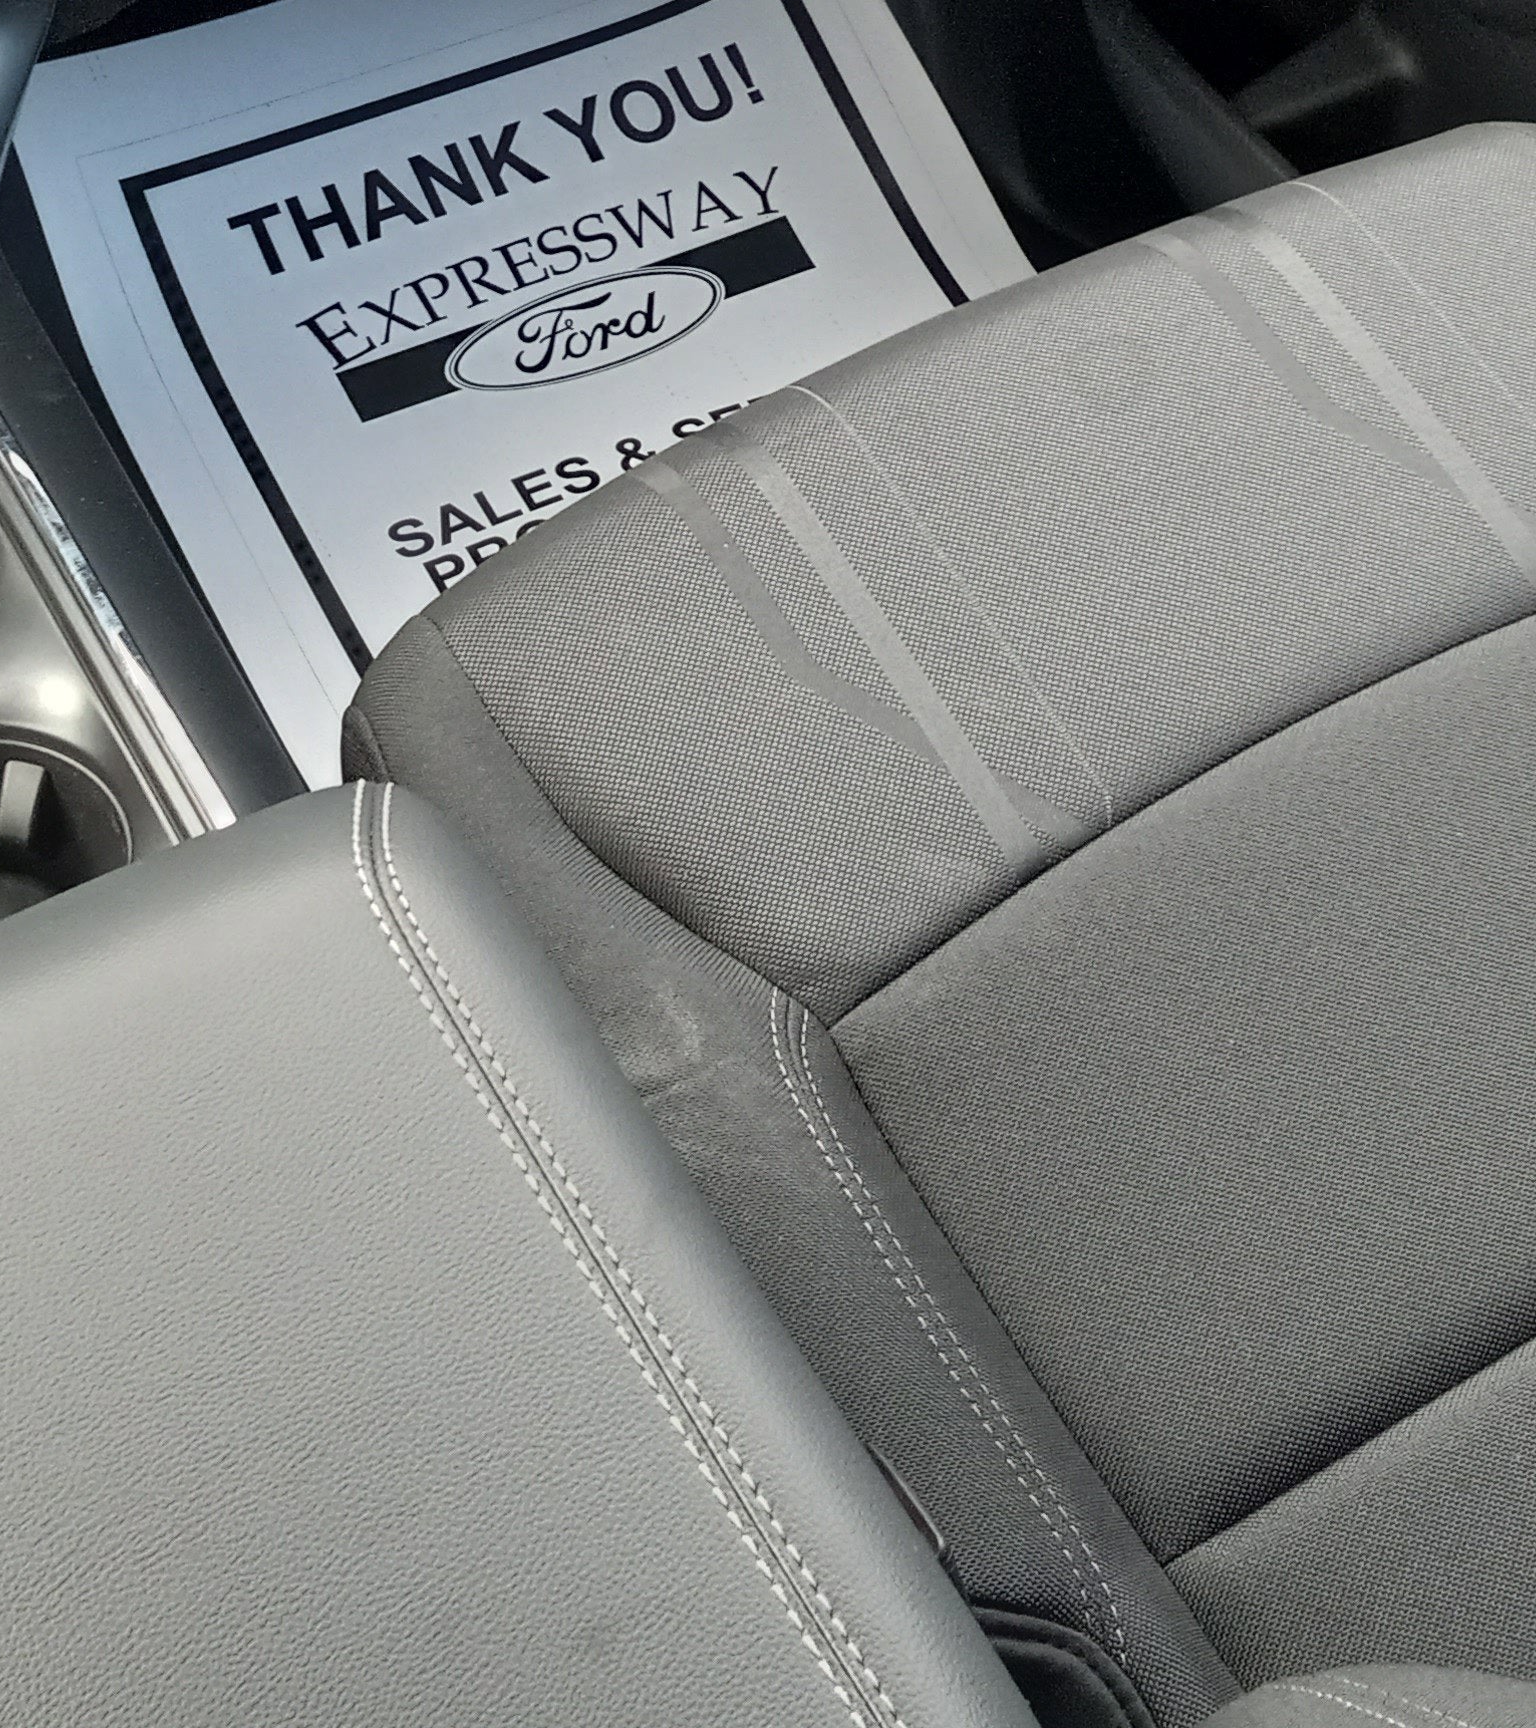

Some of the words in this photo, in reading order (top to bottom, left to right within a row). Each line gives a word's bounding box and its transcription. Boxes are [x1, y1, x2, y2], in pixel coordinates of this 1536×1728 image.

[227, 120, 550, 277] THANK
[543, 41, 768, 167] YOU!
[294, 164, 783, 373] EXPRESSWAY
[514, 289, 667, 379] Ford
[387, 456, 602, 558] SALES
[614, 436, 657, 473] &
